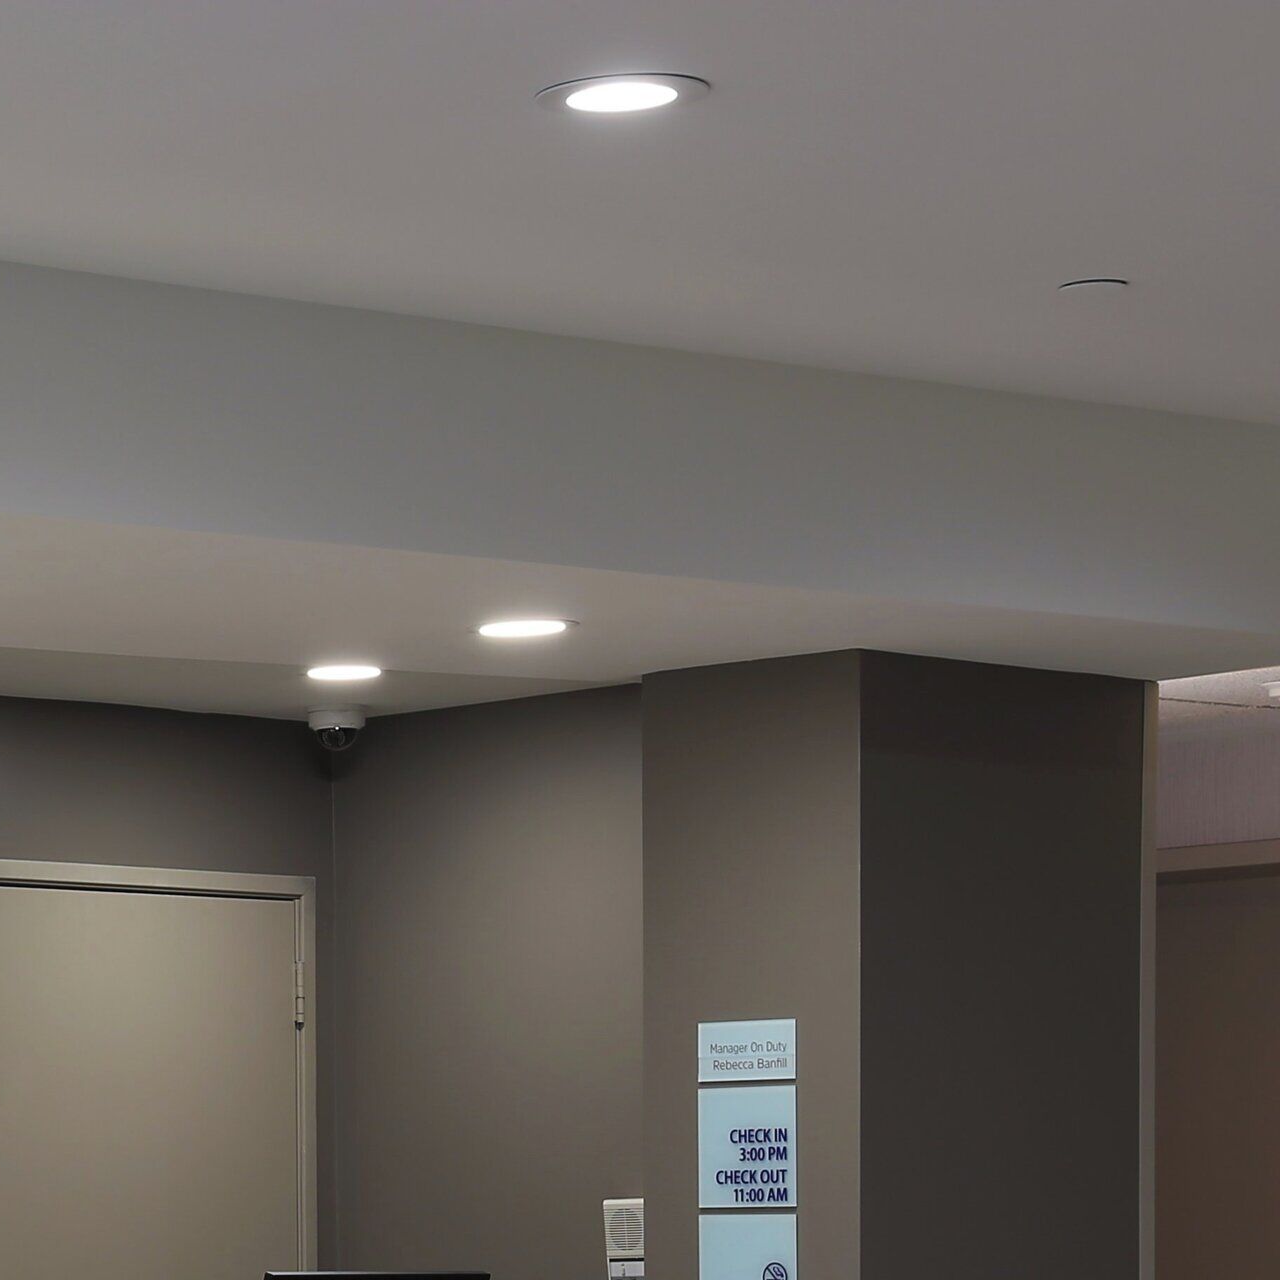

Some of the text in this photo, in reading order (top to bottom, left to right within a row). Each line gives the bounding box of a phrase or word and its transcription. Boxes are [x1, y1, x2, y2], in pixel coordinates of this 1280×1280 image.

[709, 1040, 787, 1055] Manager On Duty
[713, 1057, 788, 1071] Rebecca Banfill
[729, 1127, 788, 1144] CHECK IN
[739, 1146, 788, 1161] 3:00 PM
[715, 1169, 788, 1185] CHECK OUT
[733, 1187, 788, 1202] 11:00 AM
